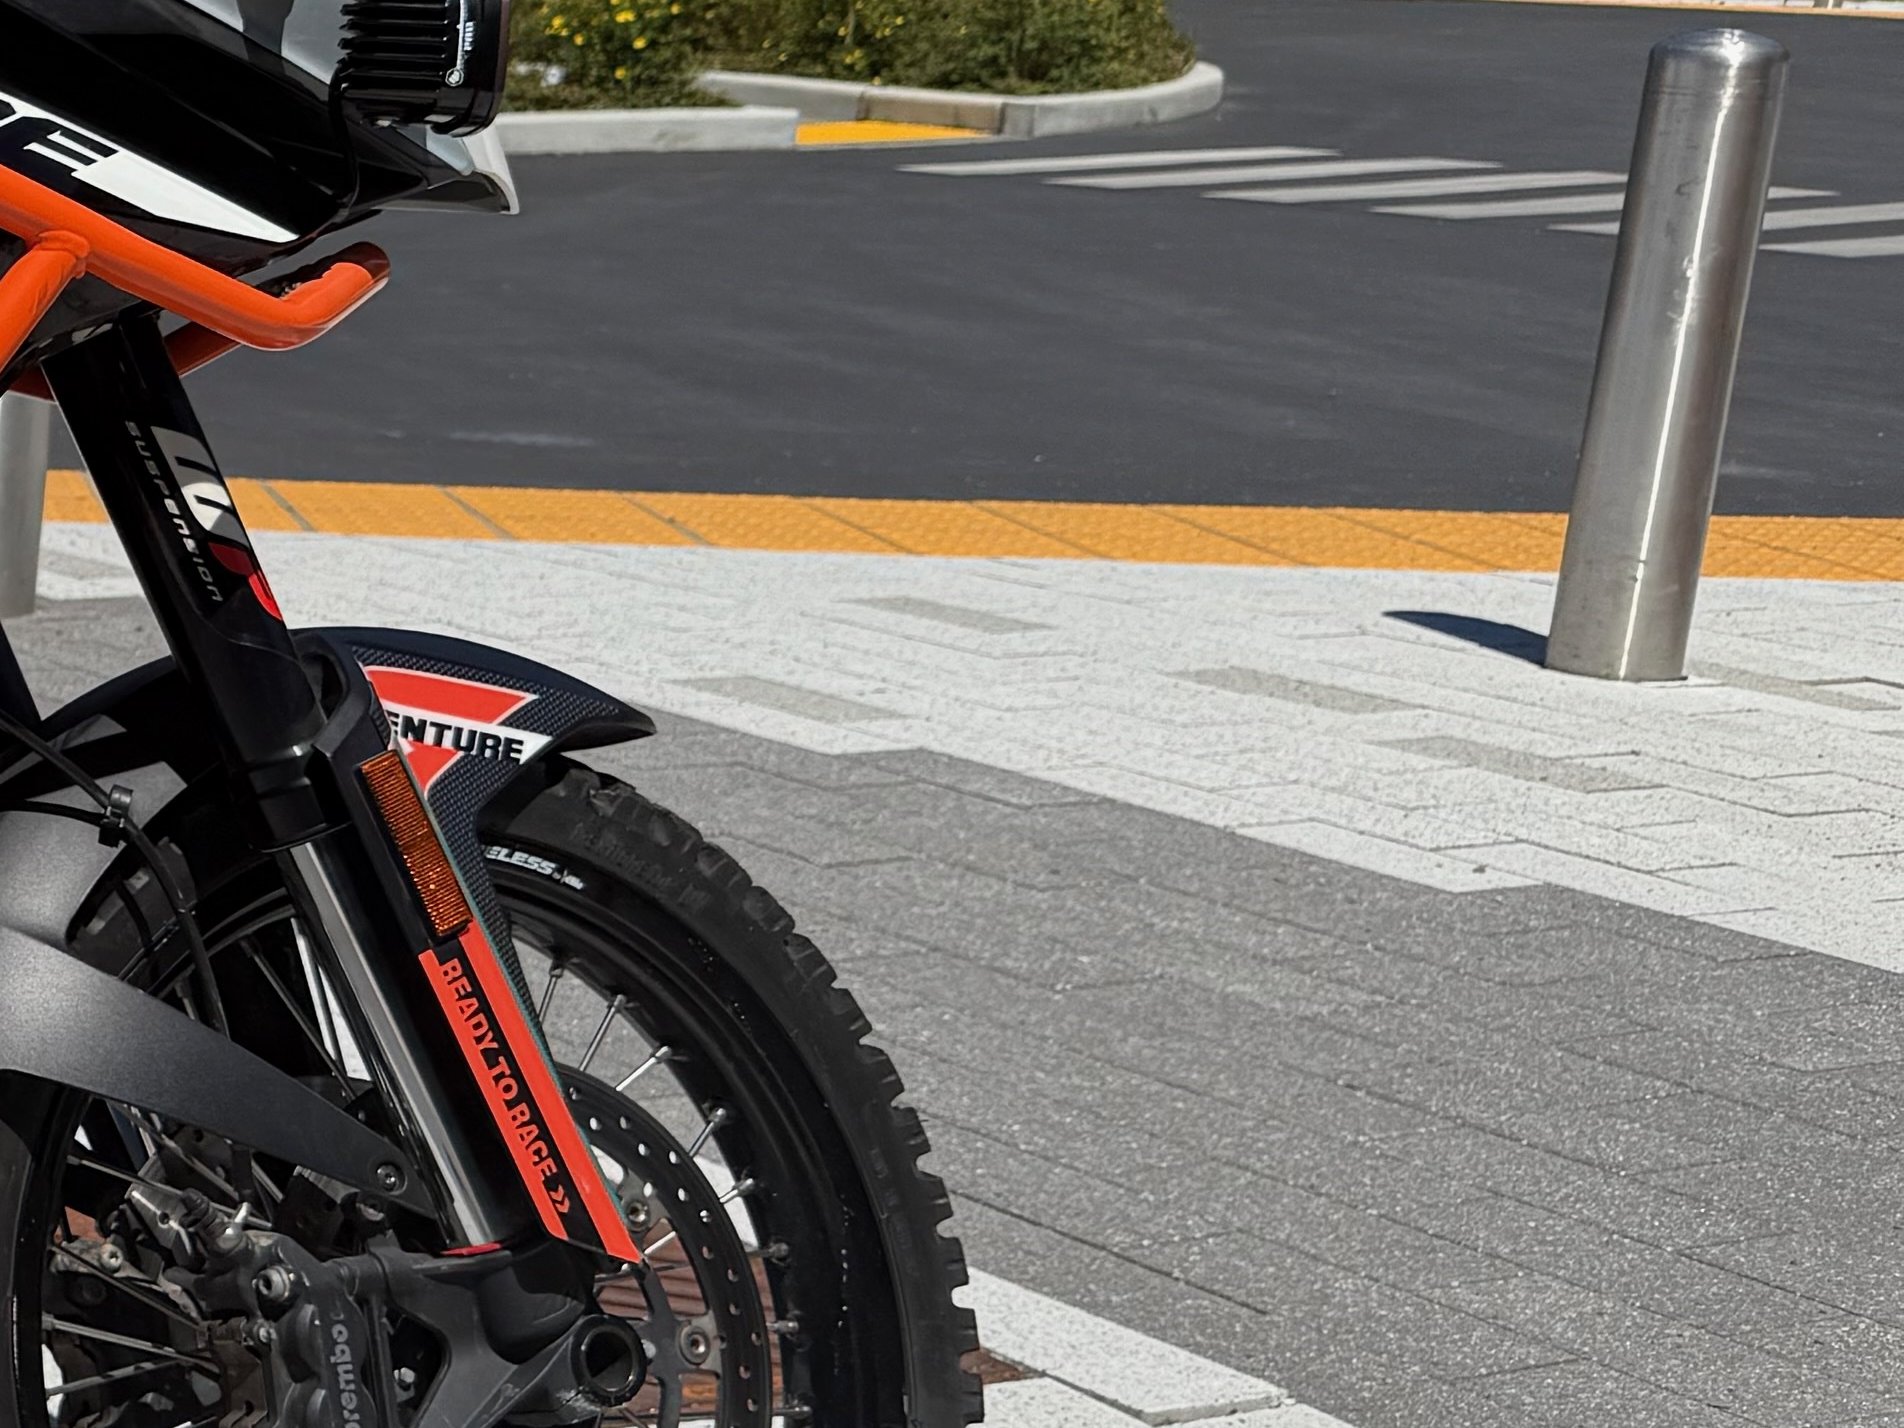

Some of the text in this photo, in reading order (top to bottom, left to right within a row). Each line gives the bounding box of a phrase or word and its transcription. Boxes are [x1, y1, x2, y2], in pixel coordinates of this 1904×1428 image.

[125, 419, 224, 602] SUSPENSION
[387, 710, 525, 763] ENTURE
[485, 845, 554, 875] ELESS
[441, 957, 558, 1179] READY TO RACE
